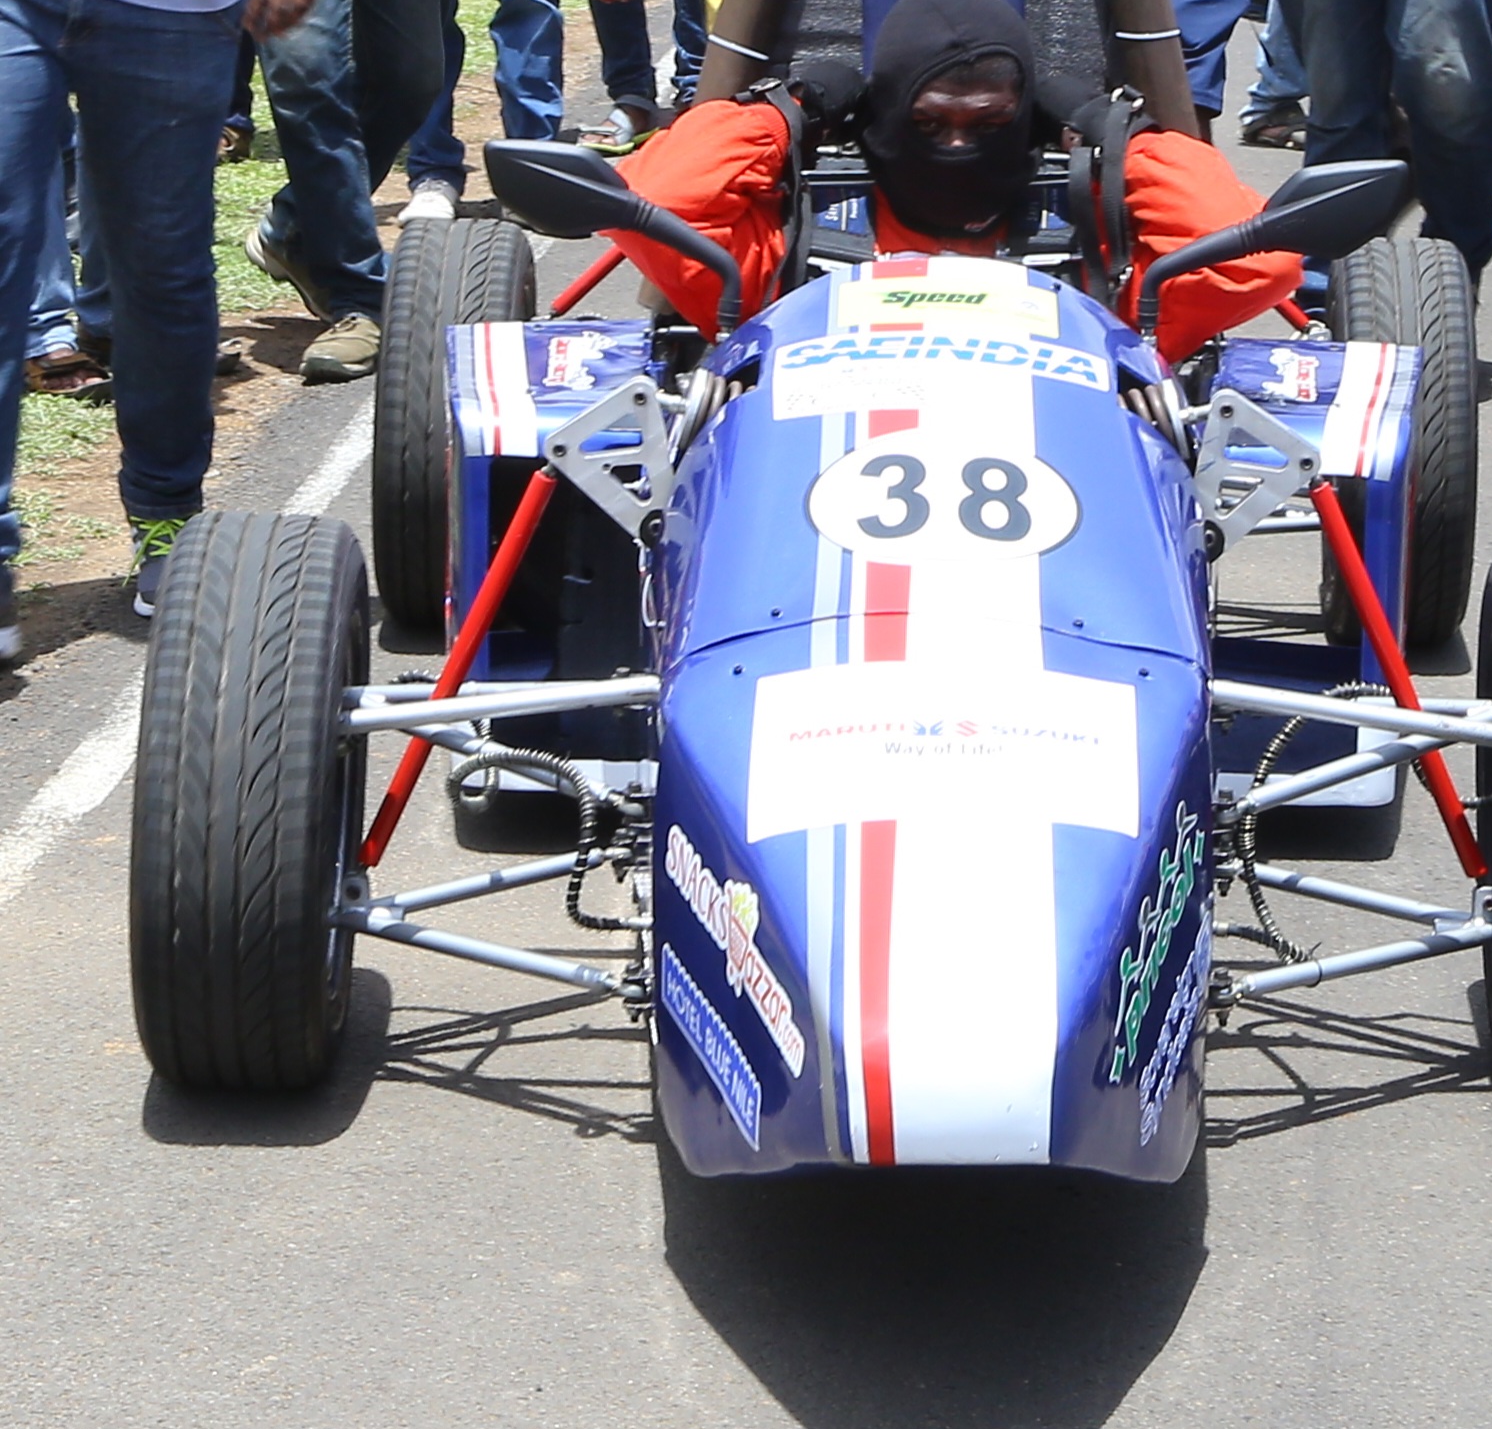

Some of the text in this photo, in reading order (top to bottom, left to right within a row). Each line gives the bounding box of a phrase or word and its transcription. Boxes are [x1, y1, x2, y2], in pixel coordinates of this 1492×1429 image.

[882, 291, 987, 308] Speed
[857, 454, 1032, 542] 38
[789, 722, 1099, 745] MARUTI SUZUKI
[884, 742, 924, 757] Way
[934, 742, 951, 754] of
[667, 828, 729, 945] SNACKS
[666, 970, 755, 1128] HOTEL BLUE NILE
